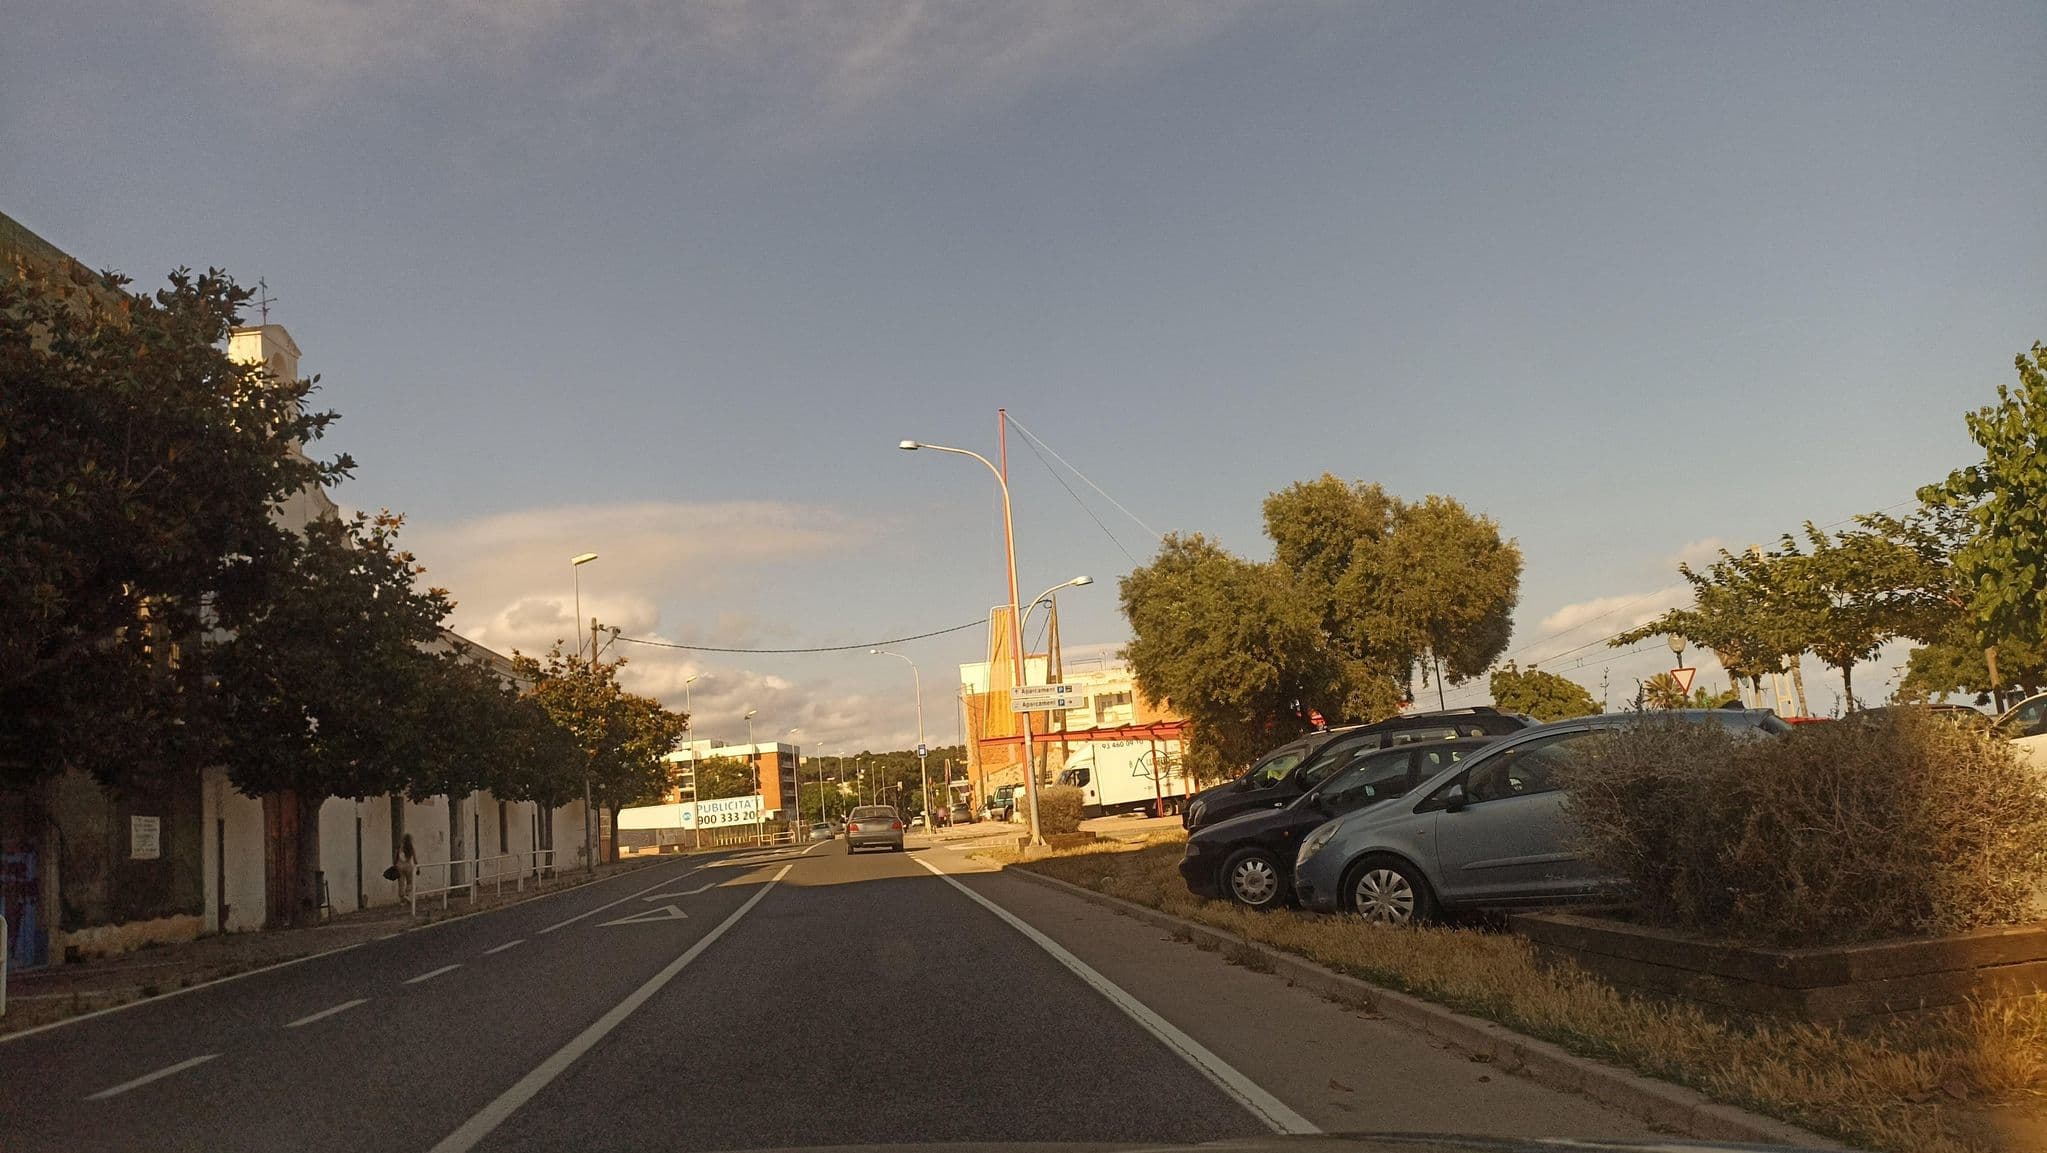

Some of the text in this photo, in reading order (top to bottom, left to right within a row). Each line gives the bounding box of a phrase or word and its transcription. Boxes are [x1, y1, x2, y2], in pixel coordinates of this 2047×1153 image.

[1021, 687, 1056, 696] Aparcament
[1022, 700, 1056, 709] Aparcament
[697, 814, 717, 825] 900
[721, 812, 739, 823] 333
